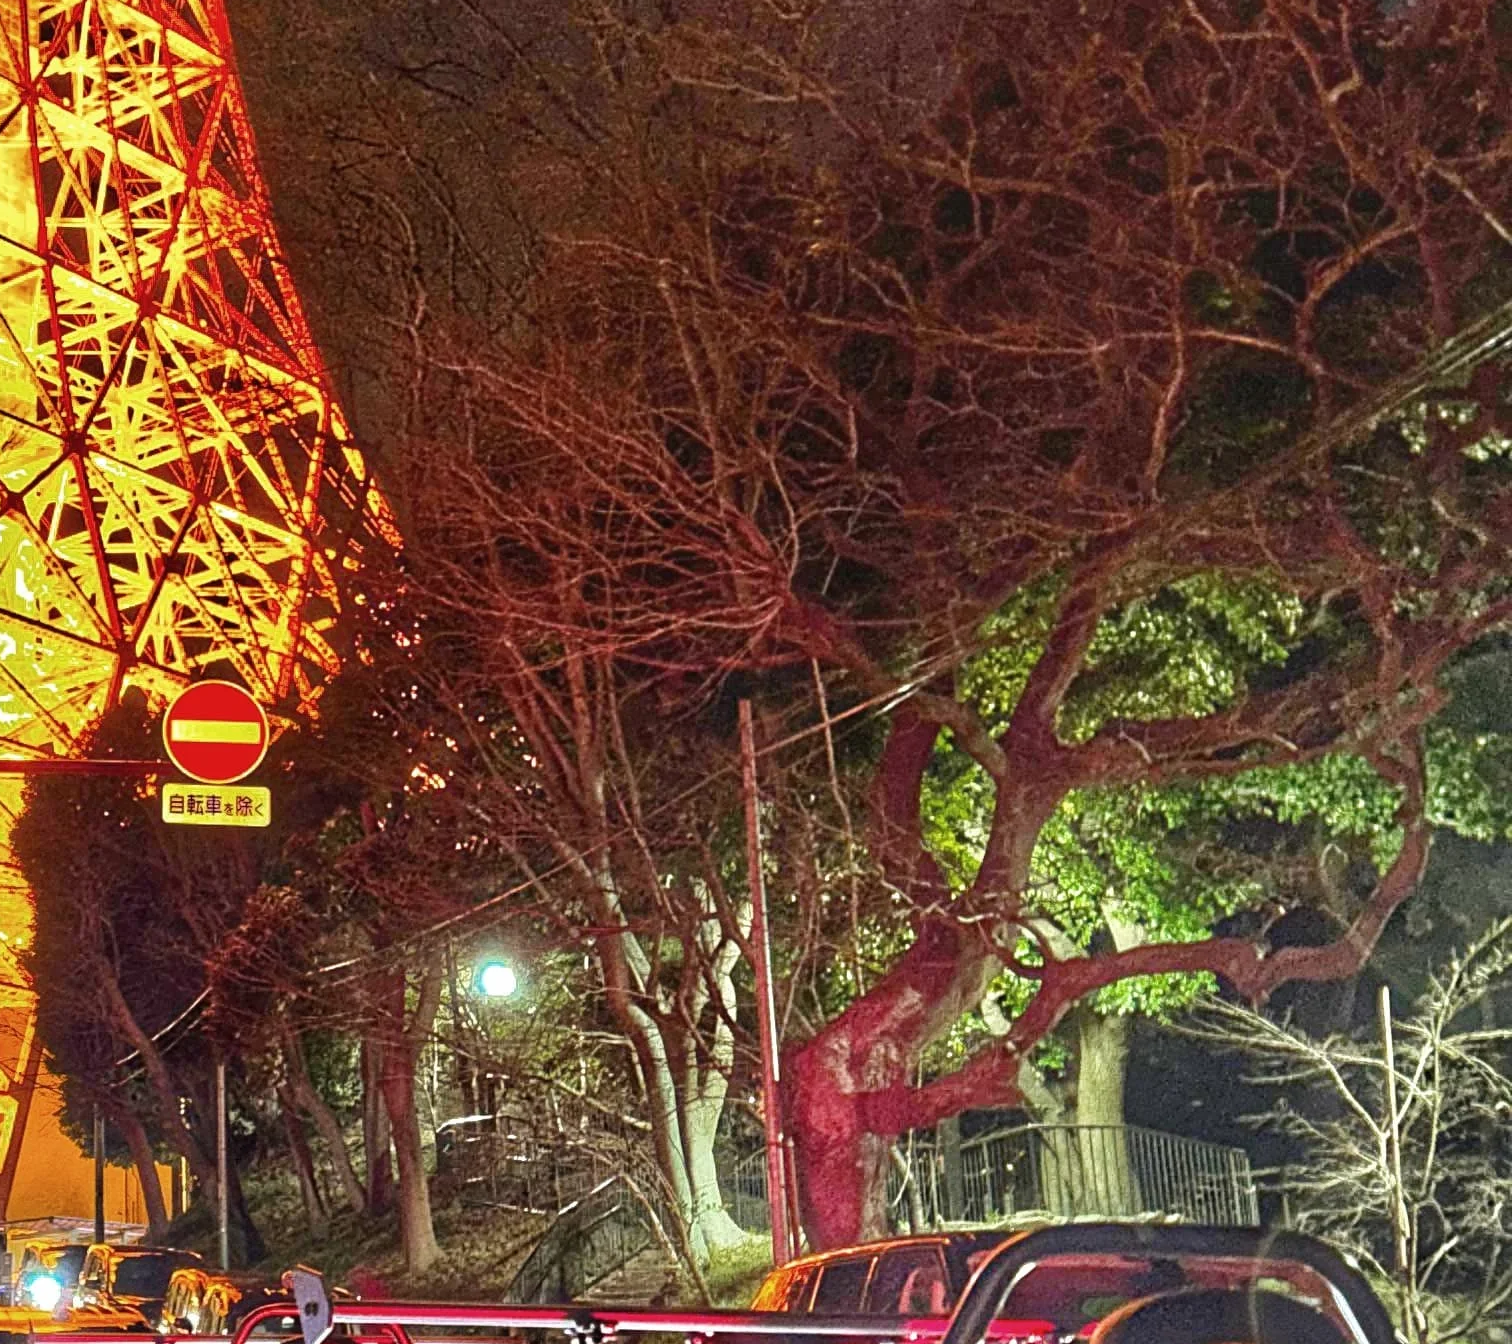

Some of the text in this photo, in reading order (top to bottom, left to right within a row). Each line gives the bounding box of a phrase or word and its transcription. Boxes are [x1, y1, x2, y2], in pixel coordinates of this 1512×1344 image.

[169, 793, 264, 817] 自転車を除く
